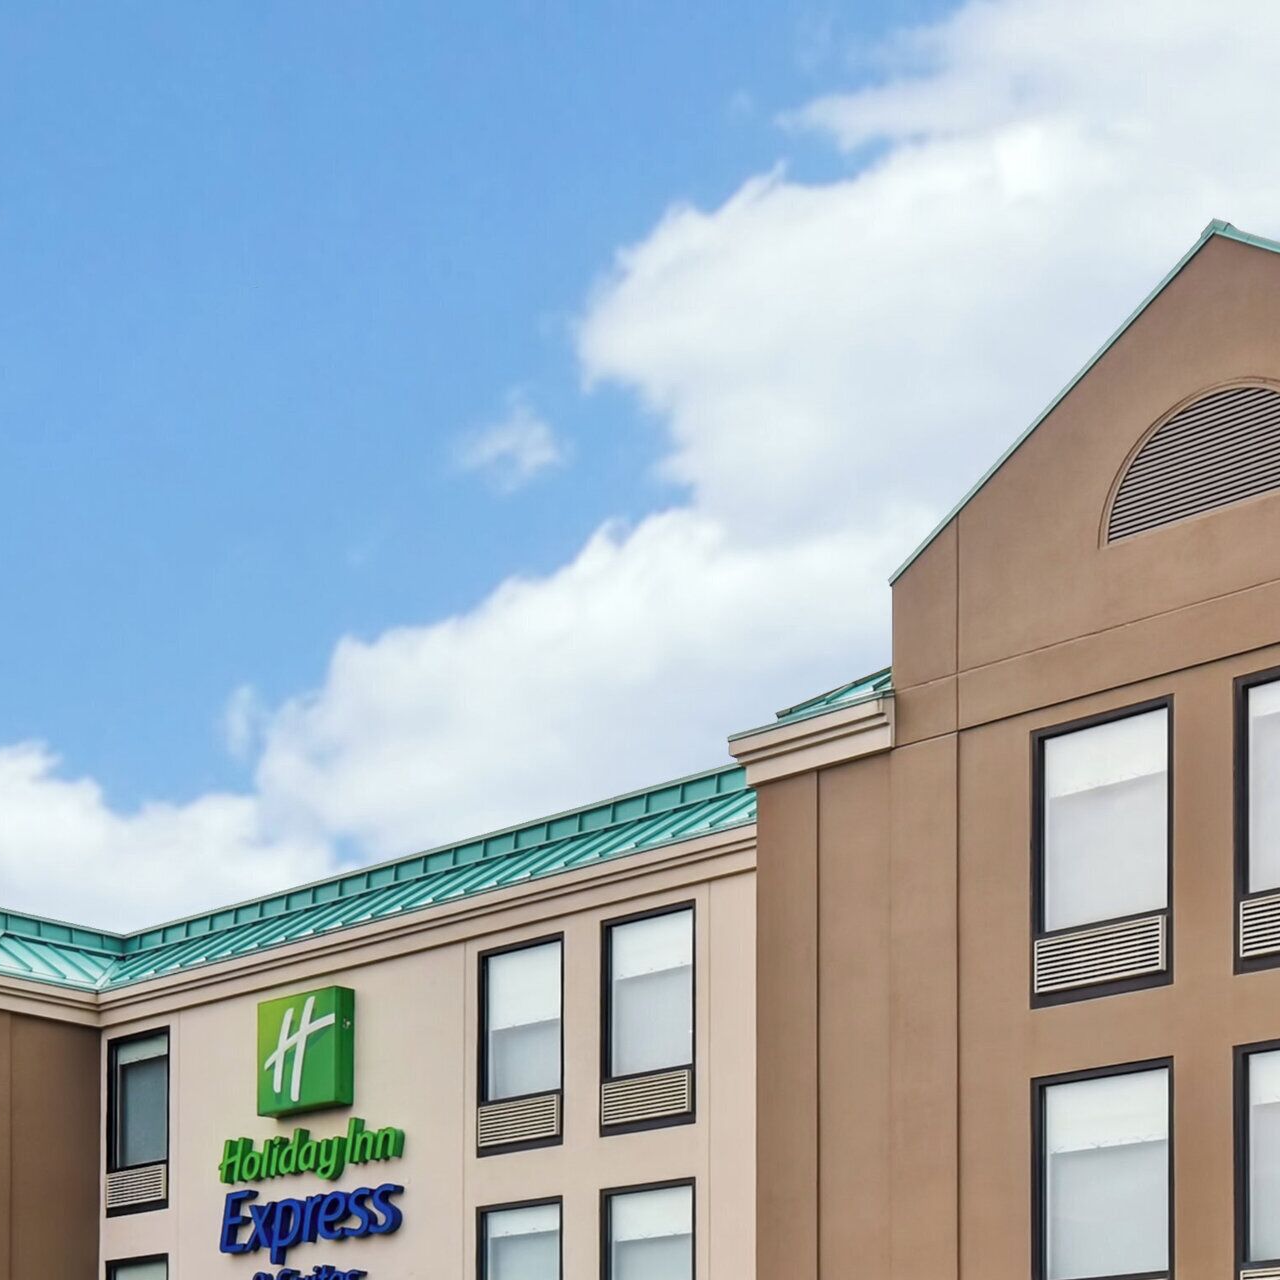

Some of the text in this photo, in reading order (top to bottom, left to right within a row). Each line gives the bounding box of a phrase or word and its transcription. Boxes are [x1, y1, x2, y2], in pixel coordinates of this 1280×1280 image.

[219, 1116, 405, 1184] Holiday Inn
[219, 1183, 404, 1265] Express
